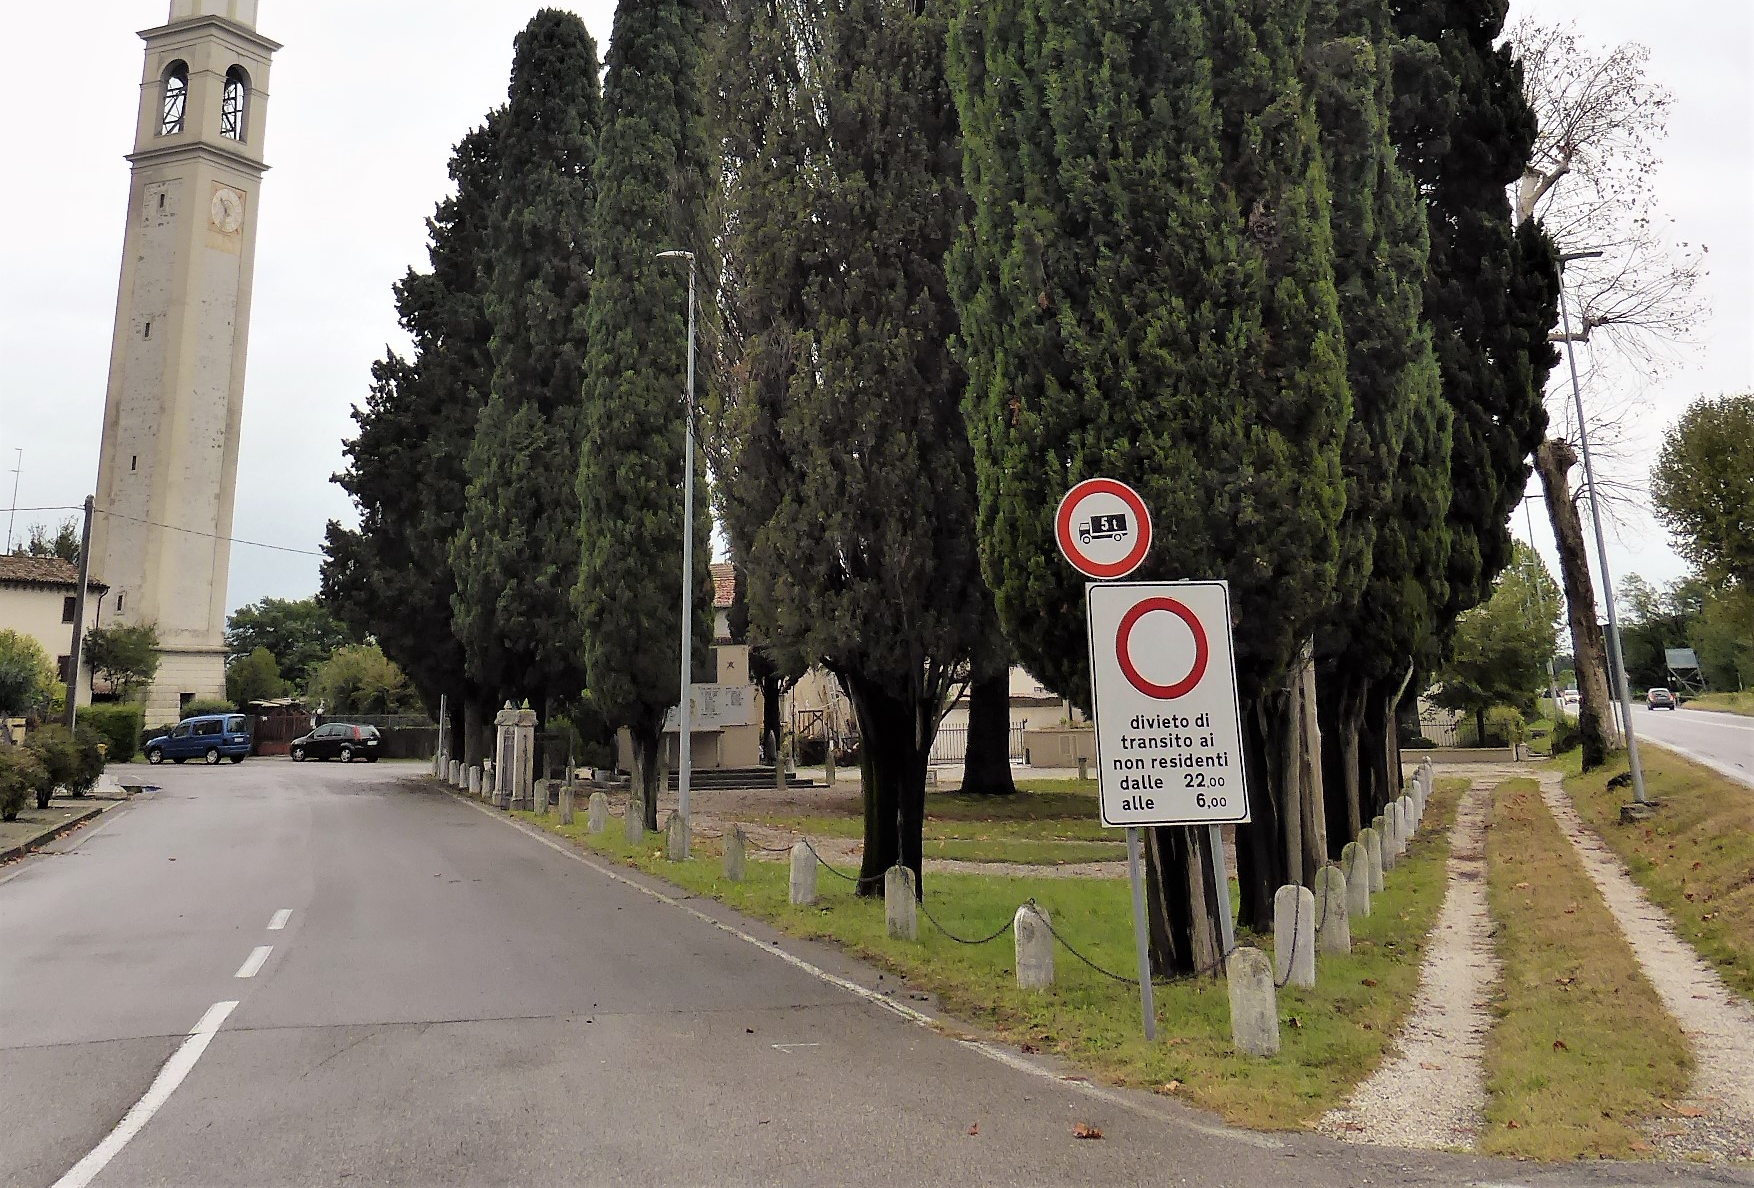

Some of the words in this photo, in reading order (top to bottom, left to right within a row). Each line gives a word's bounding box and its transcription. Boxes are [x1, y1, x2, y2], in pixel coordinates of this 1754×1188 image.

[1101, 517, 1109, 531] 5
[1112, 519, 1118, 530] t
[1130, 714, 1189, 729] divieto
[1195, 712, 1210, 727] di
[1121, 732, 1193, 749] transito
[1200, 732, 1214, 747] ai
[1113, 758, 1145, 770] non
[1151, 751, 1228, 769] residenti
[1119, 774, 1164, 790] dalle
[1122, 795, 1155, 811] alle
